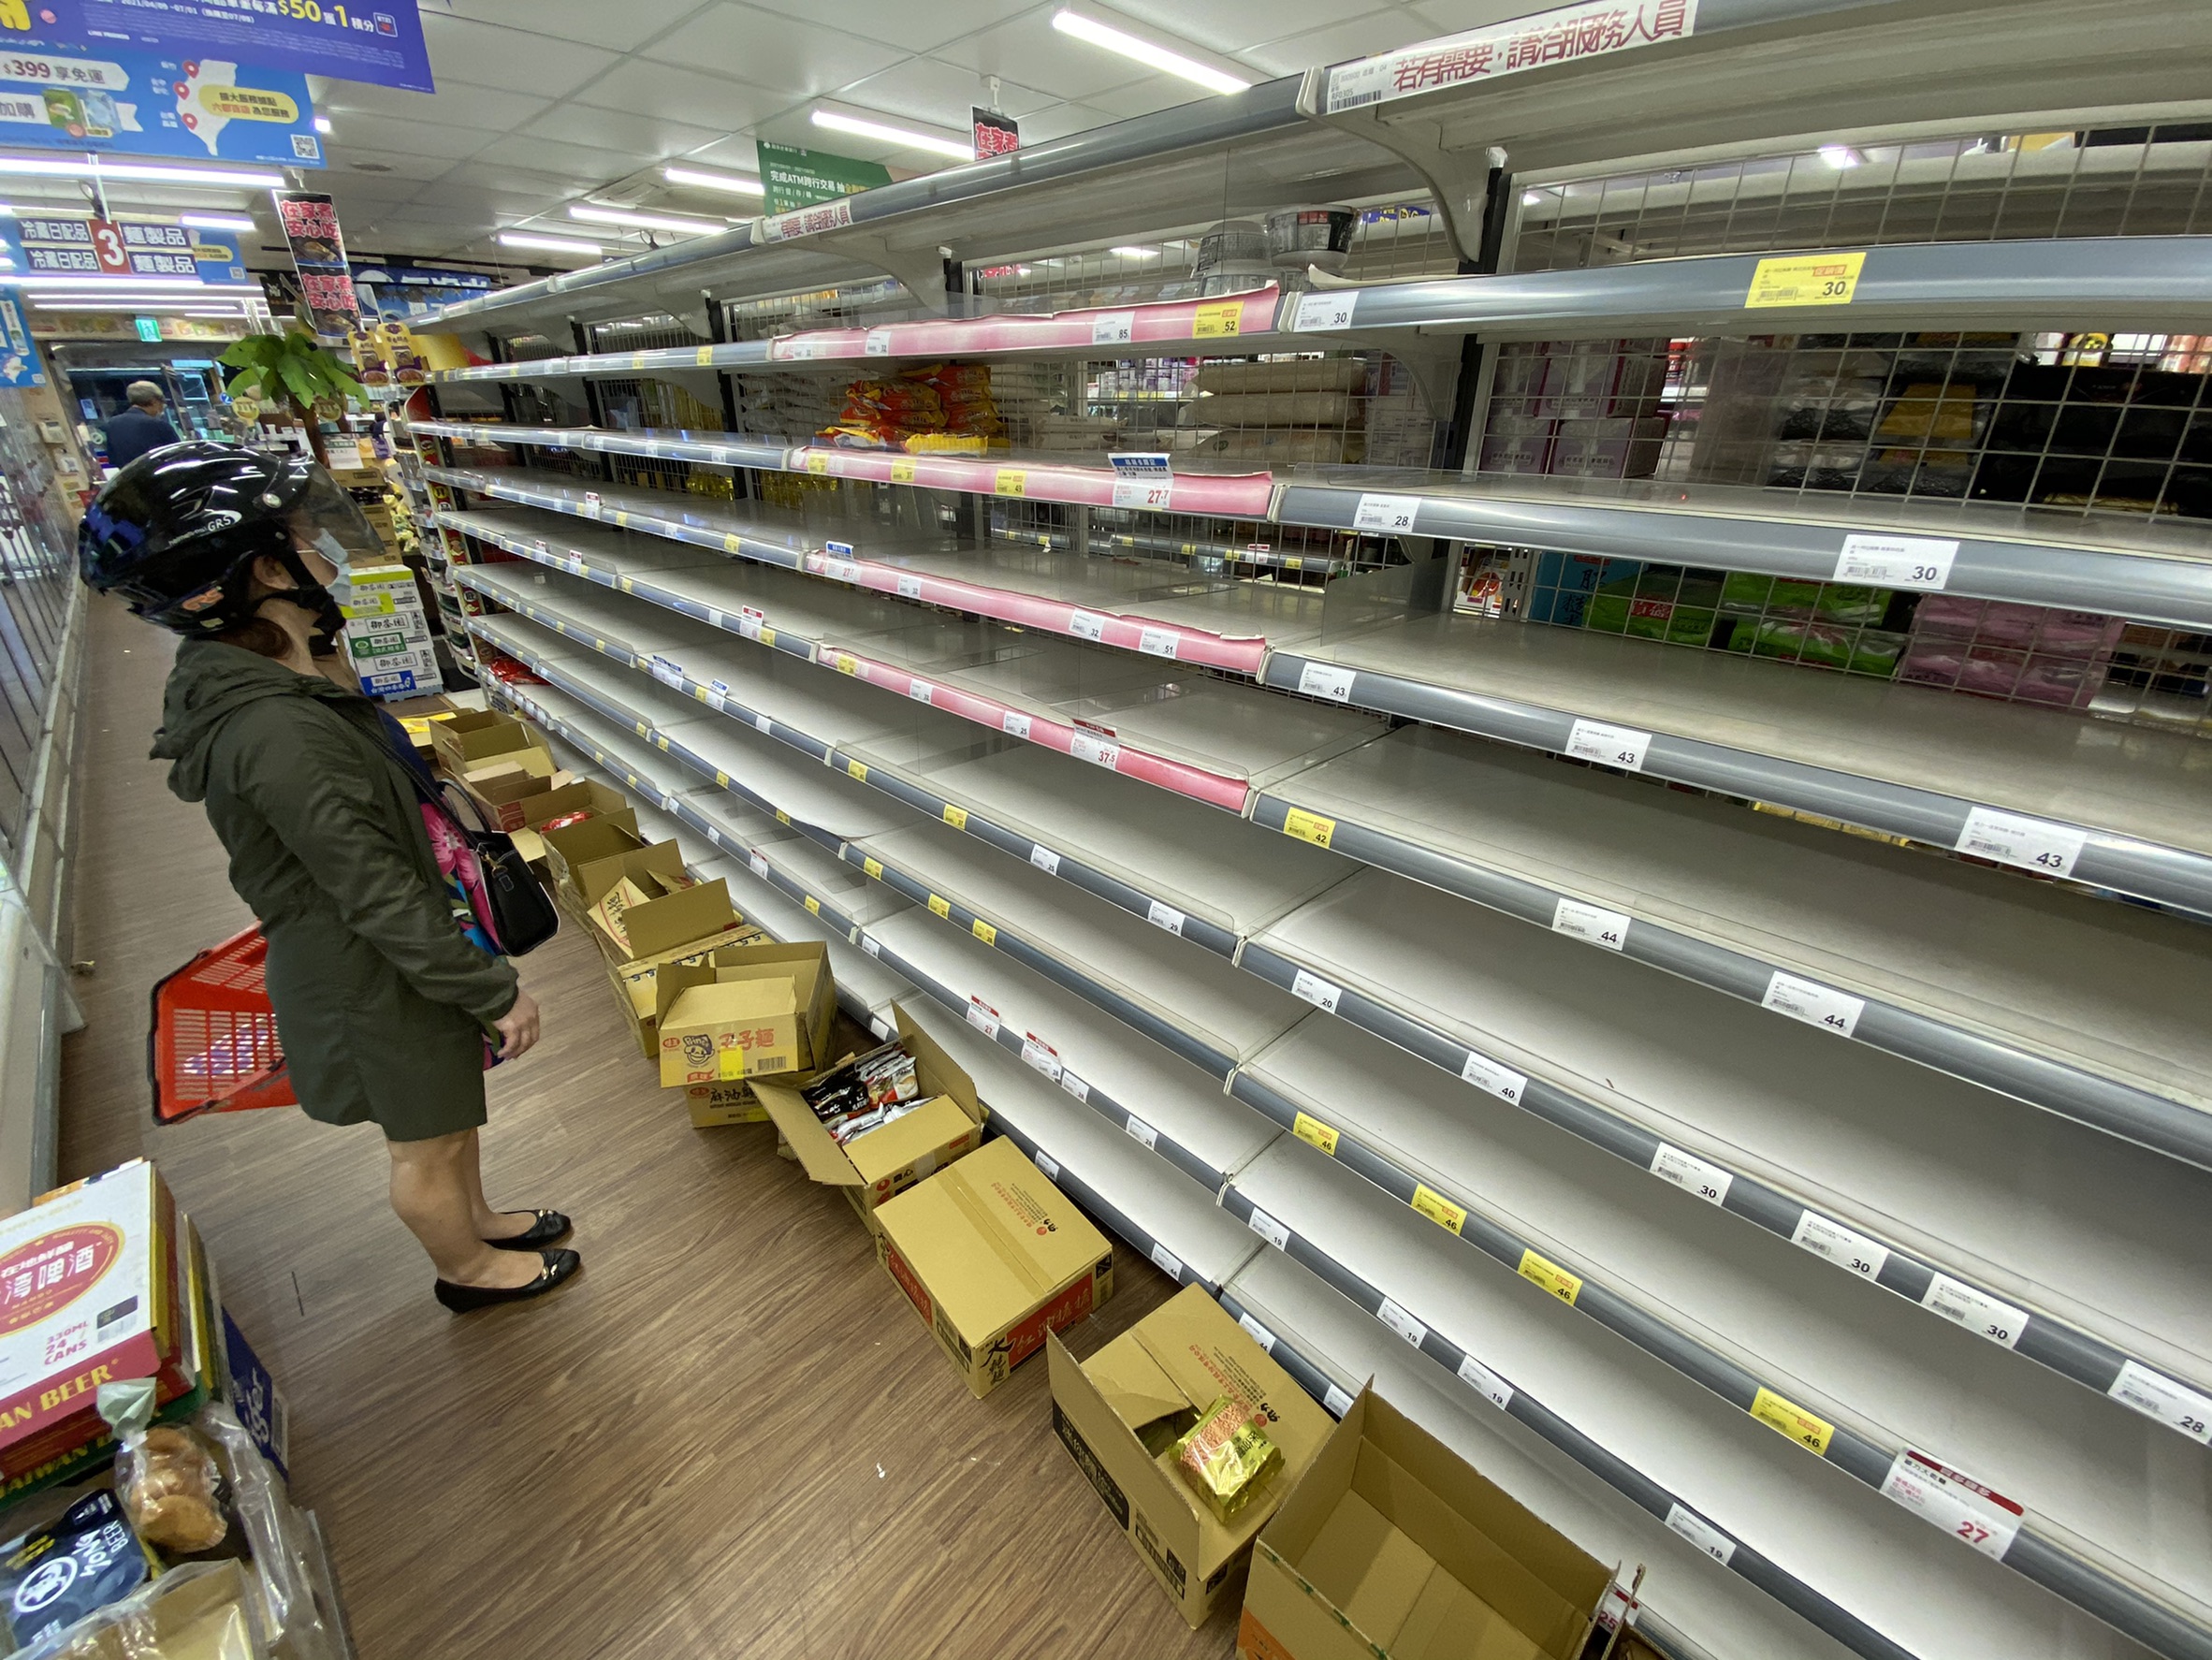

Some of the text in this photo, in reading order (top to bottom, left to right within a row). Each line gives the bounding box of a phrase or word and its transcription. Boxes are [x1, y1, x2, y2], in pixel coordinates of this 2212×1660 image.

[4, 60, 105, 84] $399 享免運
[281, 199, 335, 219] 在家煮
[21, 220, 91, 241] 冷藏日配品
[123, 226, 187, 246] 麵製品
[285, 218, 340, 240] 安心吃
[98, 228, 124, 266] 3
[30, 250, 99, 270] 冷藏日配品
[133, 255, 196, 274] 麵製品
[302, 273, 355, 293] 在家煮
[1823, 281, 1845, 296] 30
[309, 292, 357, 312] 安心吃
[1334, 313, 1347, 324] 30
[1224, 321, 1235, 331] 52
[1118, 329, 1128, 339] 85
[208, 516, 231, 531] GRS
[1395, 516, 1408, 526] 28
[1912, 566, 1937, 580] 30
[371, 619, 405, 630] 御茶園
[1091, 628, 1099, 636] 32
[1164, 645, 1173, 654] 51
[380, 656, 413, 667] 御茶園
[1333, 686, 1346, 697] 43
[1617, 751, 1635, 764] 43
[1315, 833, 1327, 844] 42
[2036, 852, 2062, 867] 43
[1601, 931, 1619, 943] 44
[1322, 998, 1332, 1009] 20
[1825, 1014, 1845, 1028] 44
[984, 1026, 993, 1034] 27
[1501, 1087, 1515, 1099] 40
[1145, 1138, 1153, 1147] 28
[1321, 1140, 1332, 1150] 46
[1700, 1185, 1717, 1199] 30
[1445, 1219, 1457, 1230] 46
[1273, 1236, 1283, 1246] 19
[1851, 1258, 1870, 1273] 30
[1557, 1288, 1571, 1299] 46
[47, 1319, 88, 1346] 330ML
[1405, 1331, 1419, 1344] 19
[1986, 1325, 2008, 1340] 30
[44, 1339, 88, 1366] CANS
[45, 1338, 67, 1356] 24
[39, 1362, 114, 1409] BEER
[1490, 1391, 1505, 1405] 19
[2179, 1416, 2205, 1434] 28
[1802, 1434, 1821, 1448] 46
[1957, 1521, 1989, 1544] 27
[109, 1518, 129, 1562] BEER
[1710, 1546, 1724, 1559] 19
[1598, 1610, 1619, 1629] 25
